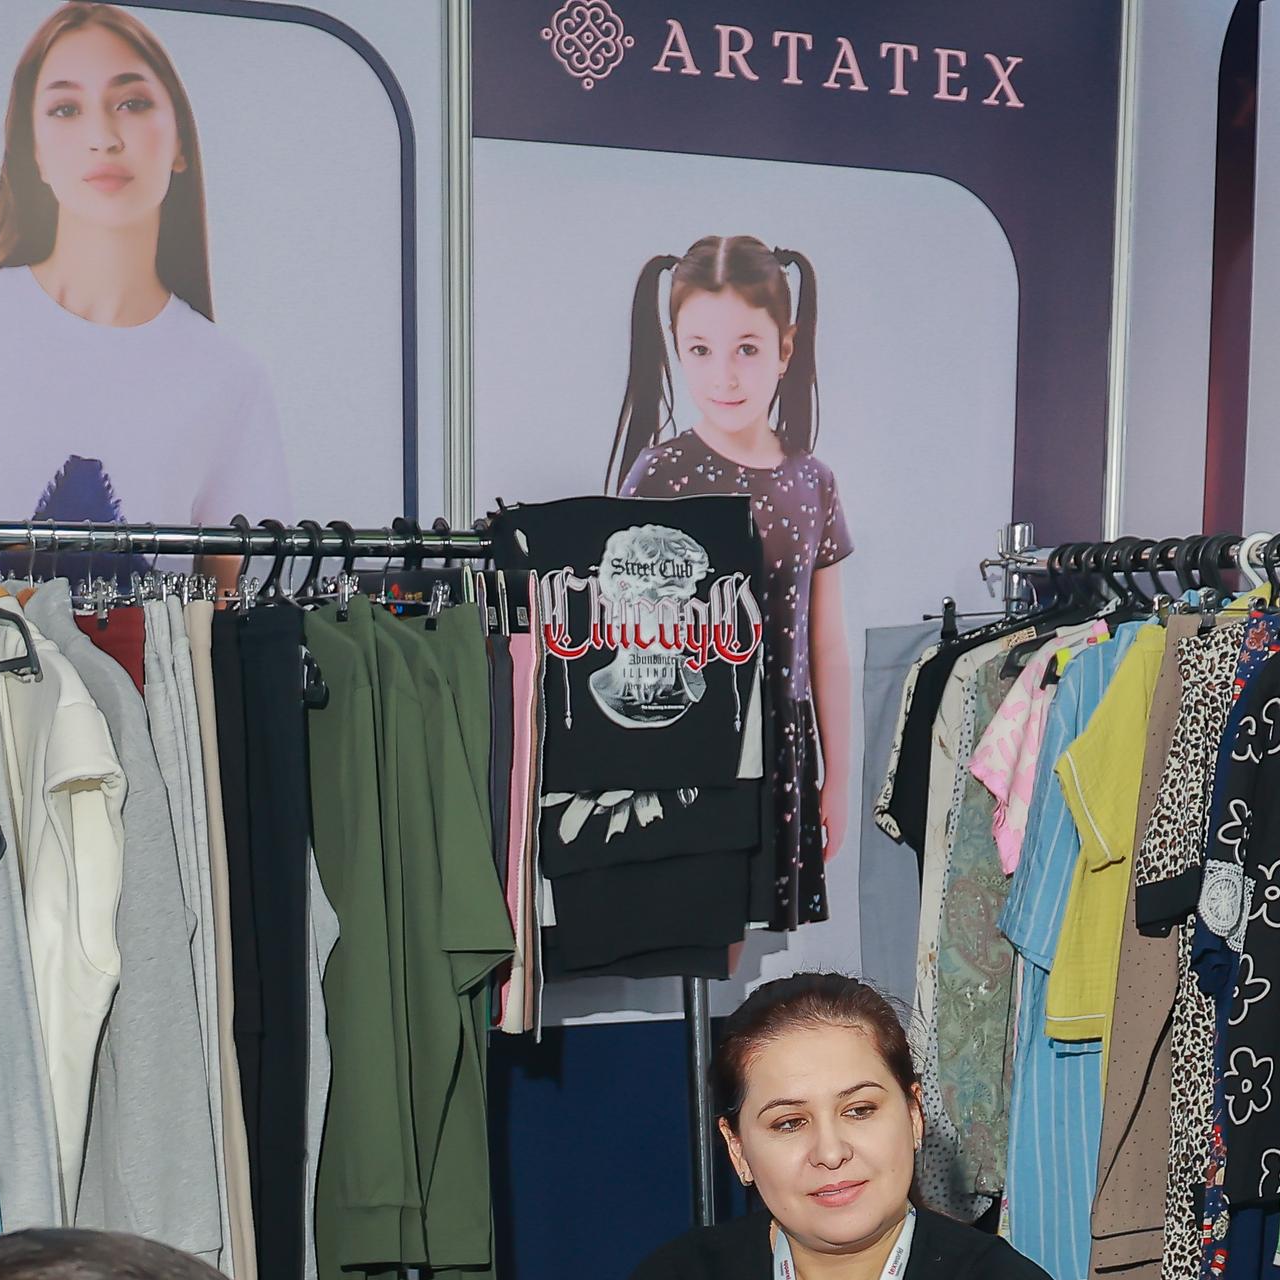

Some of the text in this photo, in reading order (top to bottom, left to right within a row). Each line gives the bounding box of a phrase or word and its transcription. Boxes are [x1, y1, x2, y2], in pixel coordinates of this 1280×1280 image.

[651, 18, 1025, 108] ARTATEX
[610, 558, 656, 578] Street
[622, 667, 676, 679] ILLINOI
